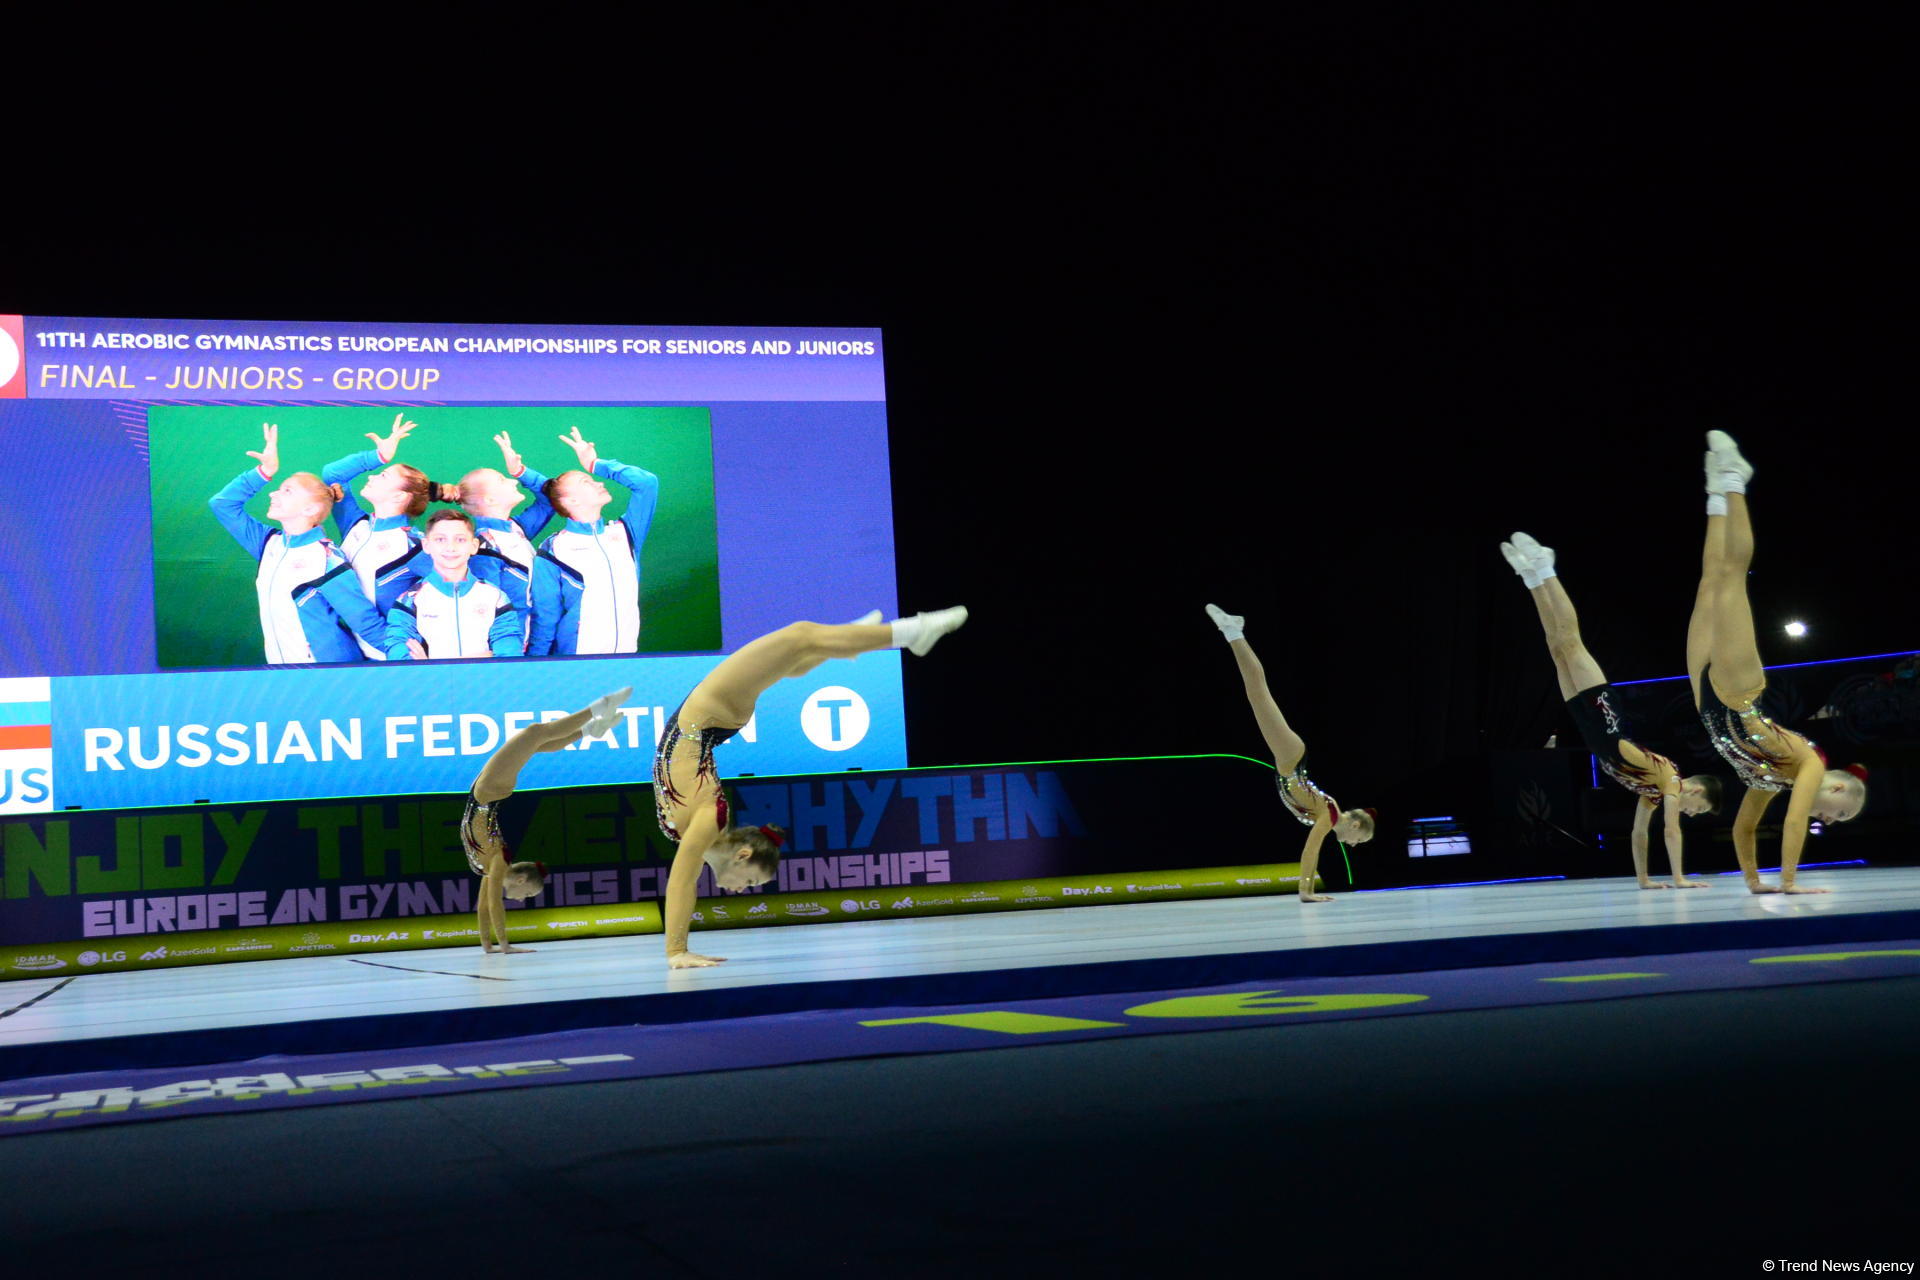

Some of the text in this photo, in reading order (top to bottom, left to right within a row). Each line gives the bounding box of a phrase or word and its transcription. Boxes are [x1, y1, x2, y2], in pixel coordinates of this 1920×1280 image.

[37, 332, 875, 357] 11TH AEROBIC GYMNASTICS EUROPEAN CHAMPIONSHIPS FOR SENIORS AND JUNIORS
[39, 364, 137, 389] FINAL
[165, 366, 304, 390] JUNIORS
[332, 368, 441, 391] GROUP
[83, 704, 757, 772] RUSSIAN FEDETI
[0, 809, 269, 899] NJOY
[297, 801, 472, 878] THE
[83, 850, 951, 938] EUROPEAN GYMNTICS CIONSHIPS
[1062, 885, 1113, 897] Day.Az
[860, 900, 881, 911] LG
[348, 931, 409, 944] Day.Az
[102, 951, 127, 963] LG
[170, 947, 217, 957] AzerGold
